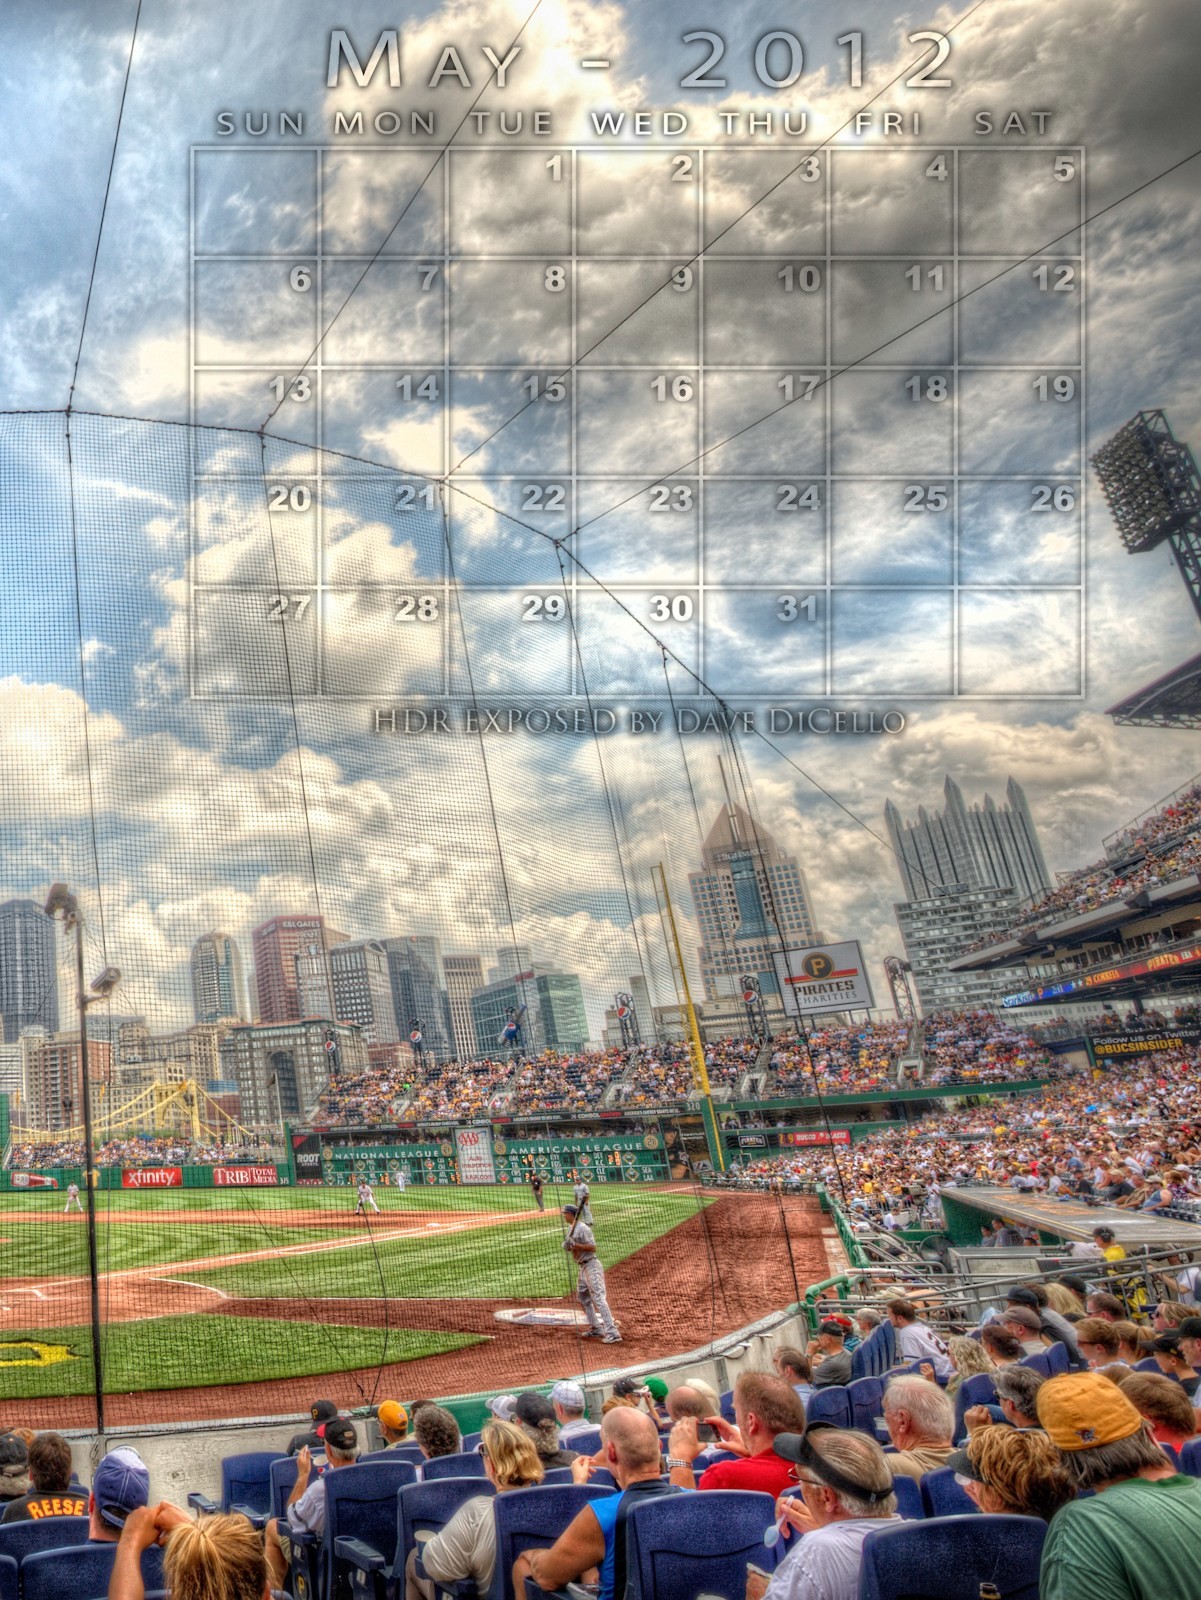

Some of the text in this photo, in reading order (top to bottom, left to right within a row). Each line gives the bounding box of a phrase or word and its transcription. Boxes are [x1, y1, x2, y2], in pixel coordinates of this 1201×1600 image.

[793, 980, 855, 997] PIRATES
[798, 991, 857, 1005] CHARITIES
[1093, 1036, 1127, 1046] Follow
[1163, 1029, 1200, 1039] Twitter
[1094, 1039, 1183, 1055] @BUCSINSIDER
[686, 1102, 700, 1110] 320
[459, 1132, 479, 1145] AAA
[395, 1150, 439, 1158] LEAGUE
[510, 1143, 642, 1154] AMERICAN LEAGUE
[297, 1154, 320, 1163] ROOT
[128, 1169, 175, 1187] xfinity
[214, 1168, 249, 1184] TRIB
[250, 1167, 275, 1175] TOTAL
[312, 1408, 318, 1419] P
[27, 1498, 85, 1519] REESE
